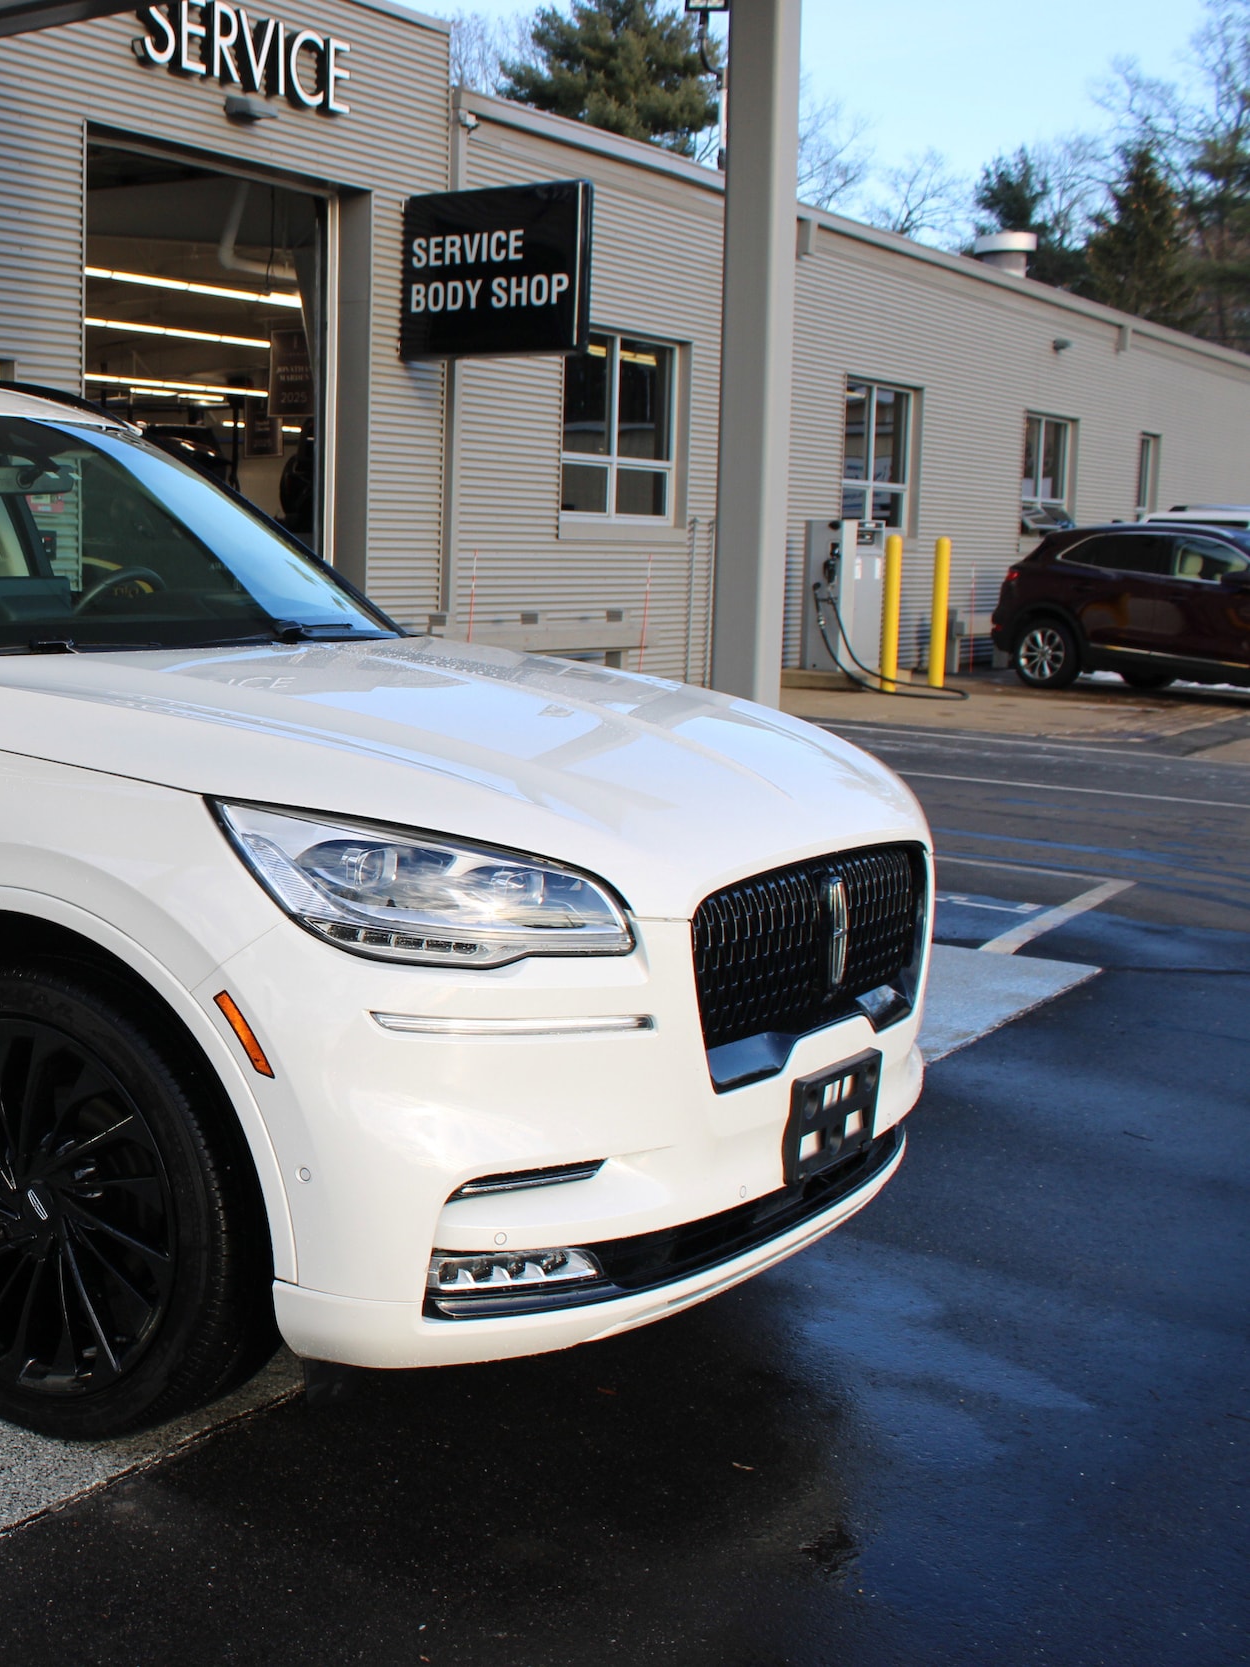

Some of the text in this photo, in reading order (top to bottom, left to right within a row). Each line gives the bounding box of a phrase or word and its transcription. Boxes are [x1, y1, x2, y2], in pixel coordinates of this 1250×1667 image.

[138, 0, 350, 114] SERVICE
[412, 229, 524, 269] SERVICE
[411, 272, 570, 313] BODY SHOP
[280, 391, 308, 404] 2025
